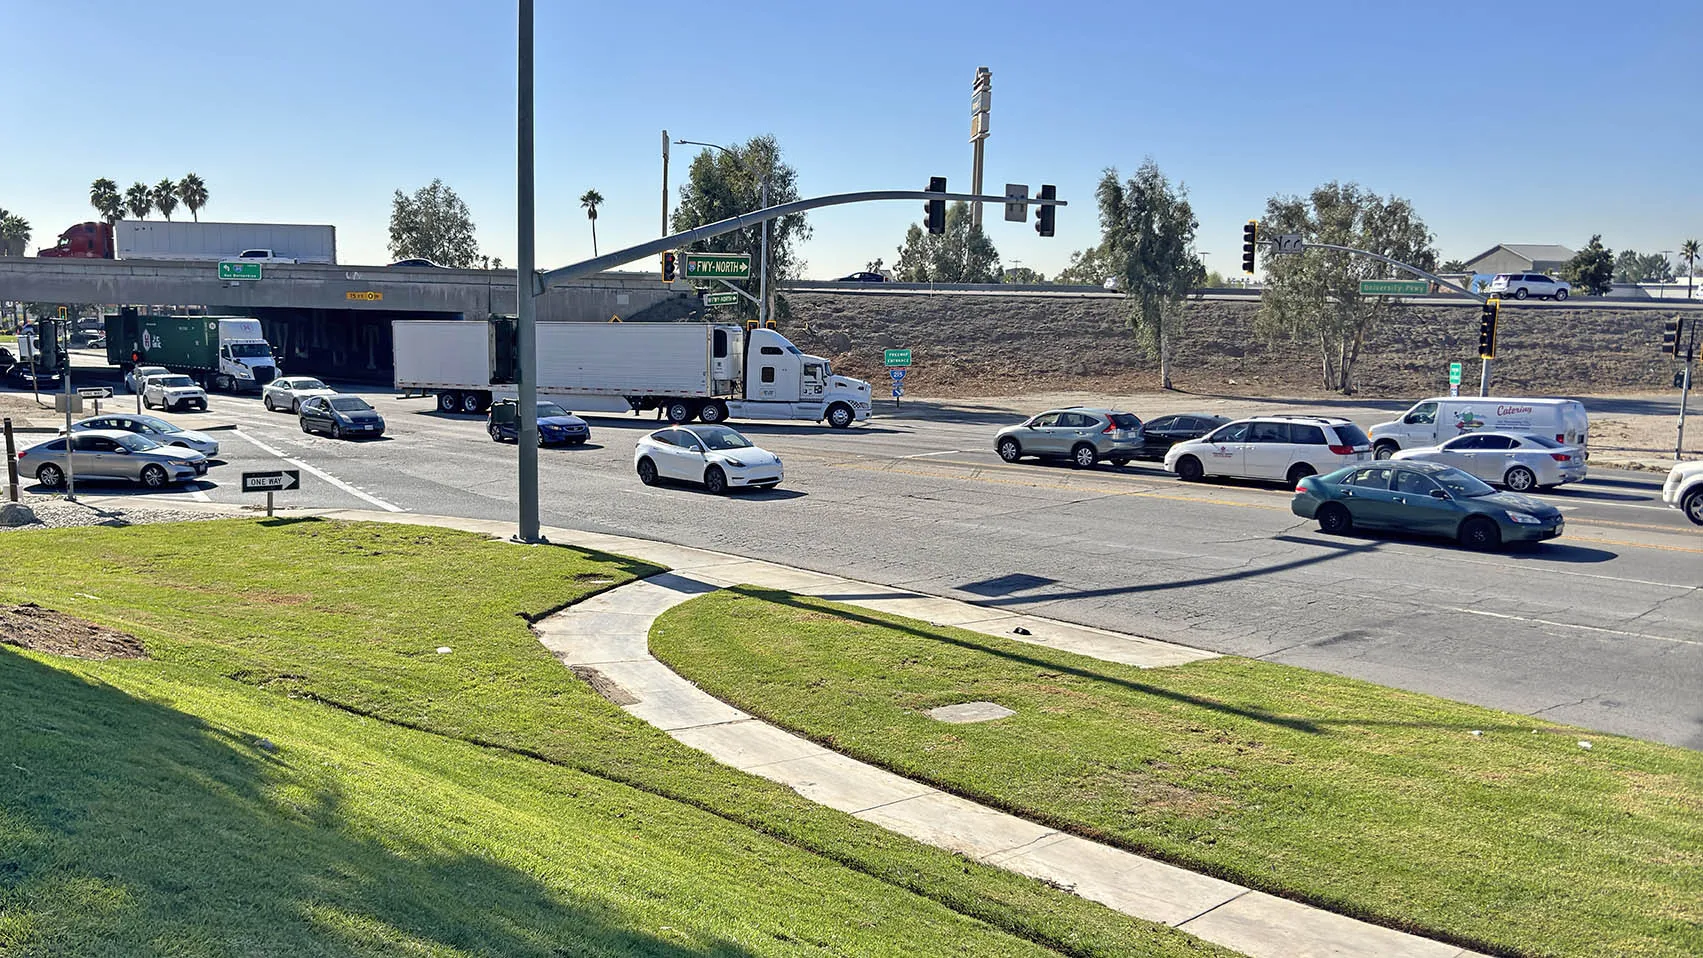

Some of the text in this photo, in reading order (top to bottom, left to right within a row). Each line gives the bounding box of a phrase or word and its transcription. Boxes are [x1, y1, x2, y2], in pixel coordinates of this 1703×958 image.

[696, 261, 739, 272] FWY-NORTH
[1364, 284, 1402, 292] University
[1497, 405, 1532, 416] Catering
[250, 477, 282, 486] ONE WAY
